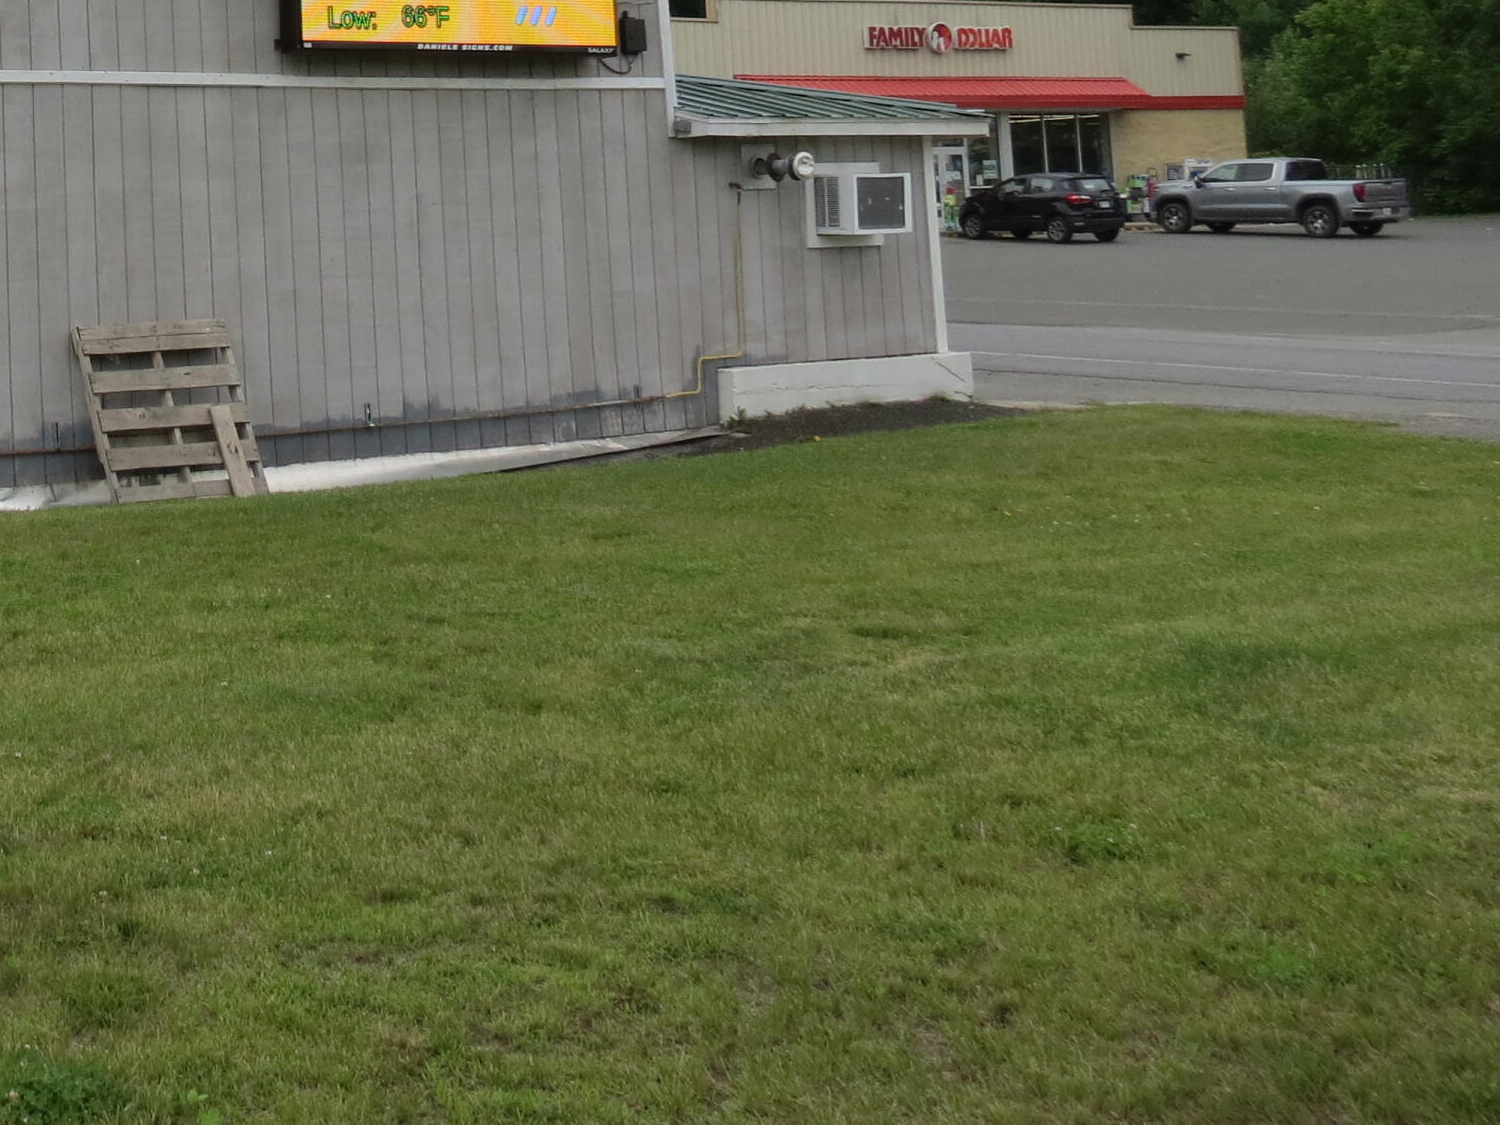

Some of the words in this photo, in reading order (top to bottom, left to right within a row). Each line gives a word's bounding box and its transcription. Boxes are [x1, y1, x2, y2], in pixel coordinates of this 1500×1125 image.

[327, 5, 377, 30] Low:
[867, 26, 926, 48] FAMILY
[956, 27, 1013, 48] DOLLAR
